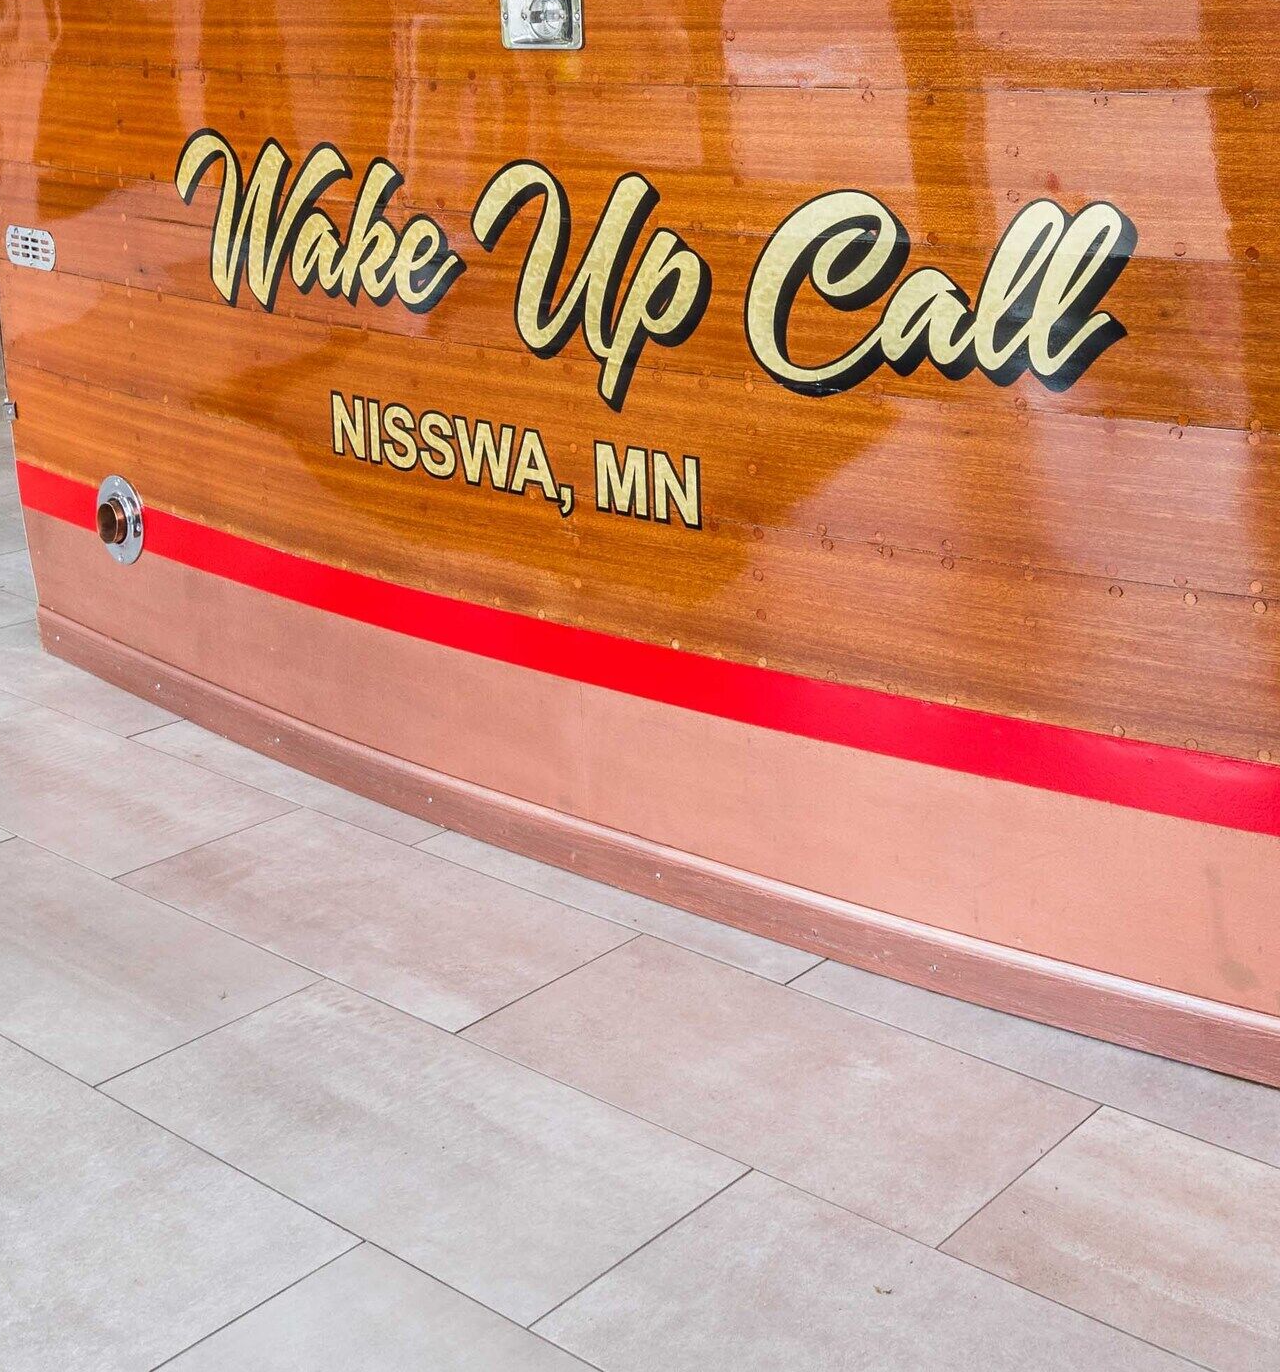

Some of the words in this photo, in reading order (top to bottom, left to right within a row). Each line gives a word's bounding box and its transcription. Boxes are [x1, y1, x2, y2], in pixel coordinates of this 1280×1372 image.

[174, 127, 468, 315] Wake
[470, 159, 714, 414] Up
[743, 188, 1138, 398] Call
[330, 390, 575, 518] NISSWA,
[593, 439, 703, 531] MN
